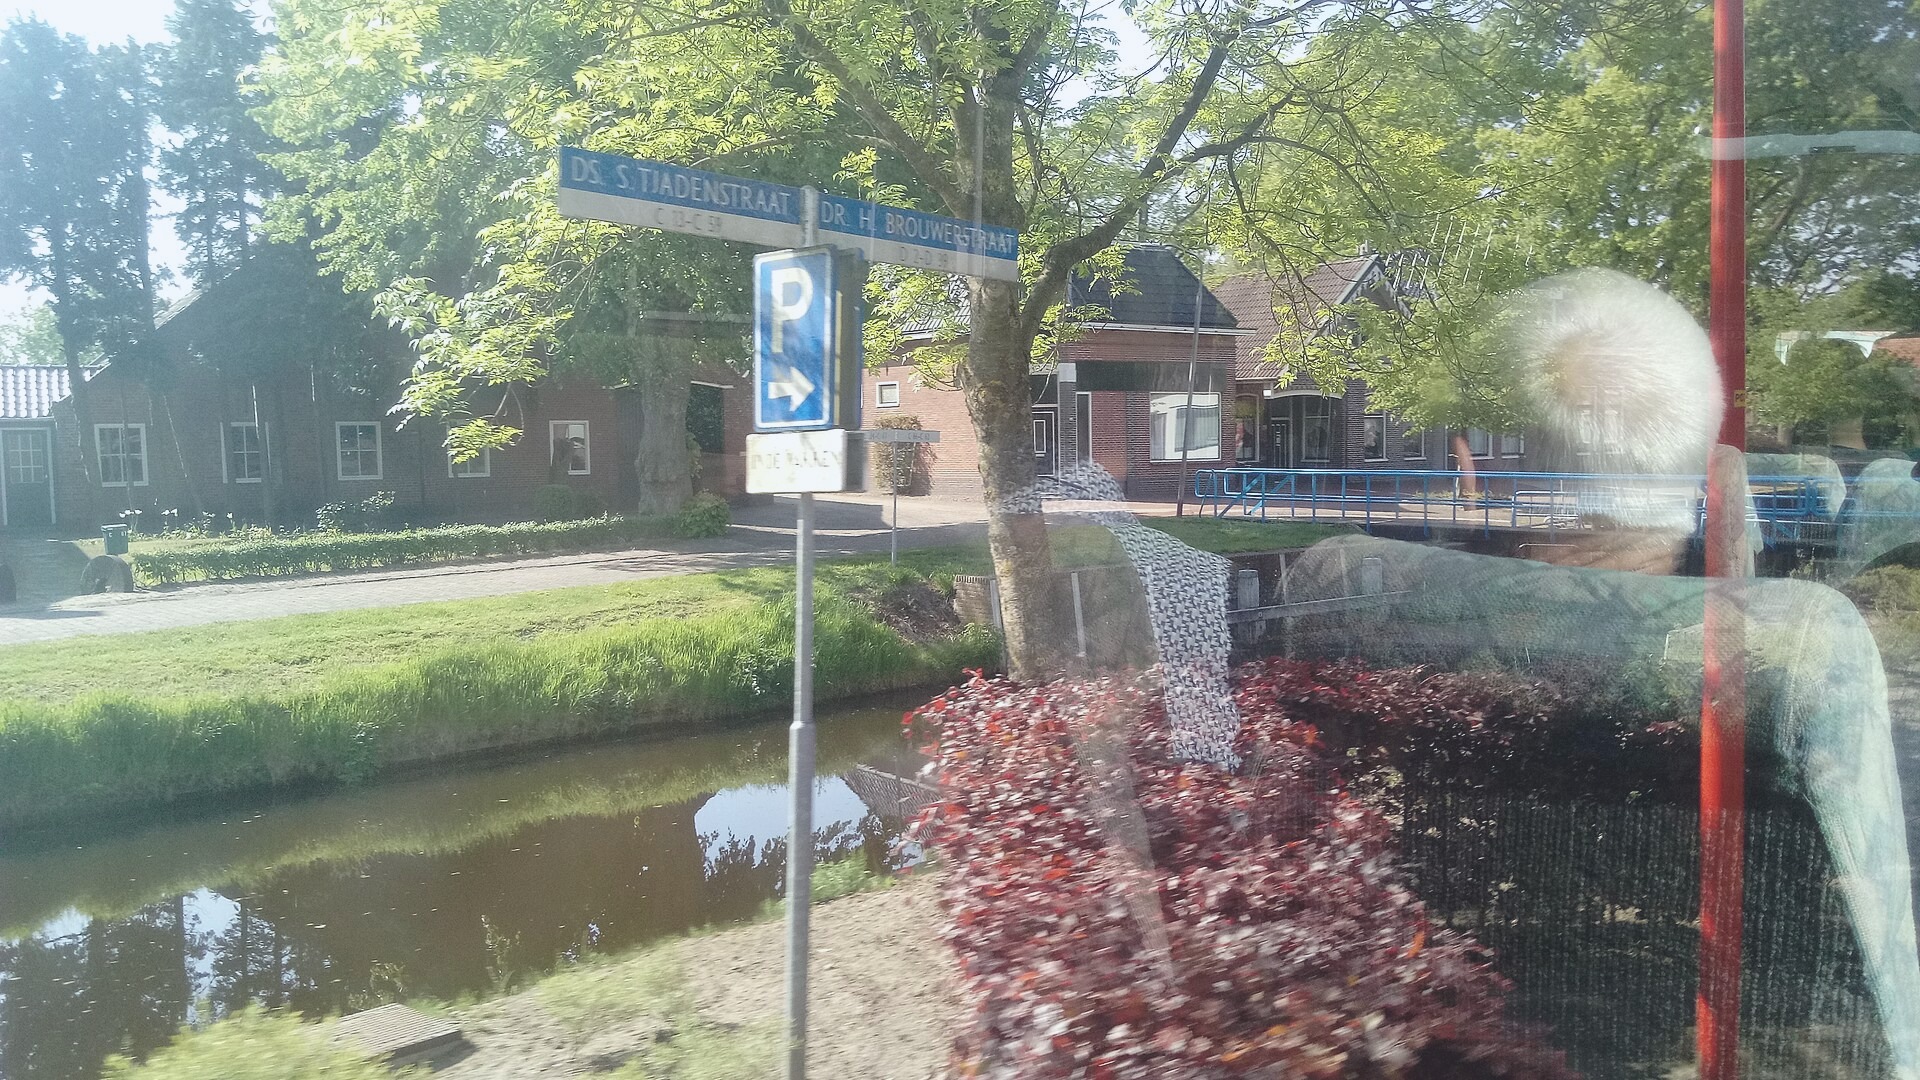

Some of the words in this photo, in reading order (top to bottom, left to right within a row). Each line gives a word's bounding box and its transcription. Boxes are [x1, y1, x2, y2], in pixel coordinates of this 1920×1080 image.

[638, 167, 790, 215] TJADENSTRAAT
[886, 212, 1014, 254] BROUWERSTRAAT
[771, 267, 813, 353] P
